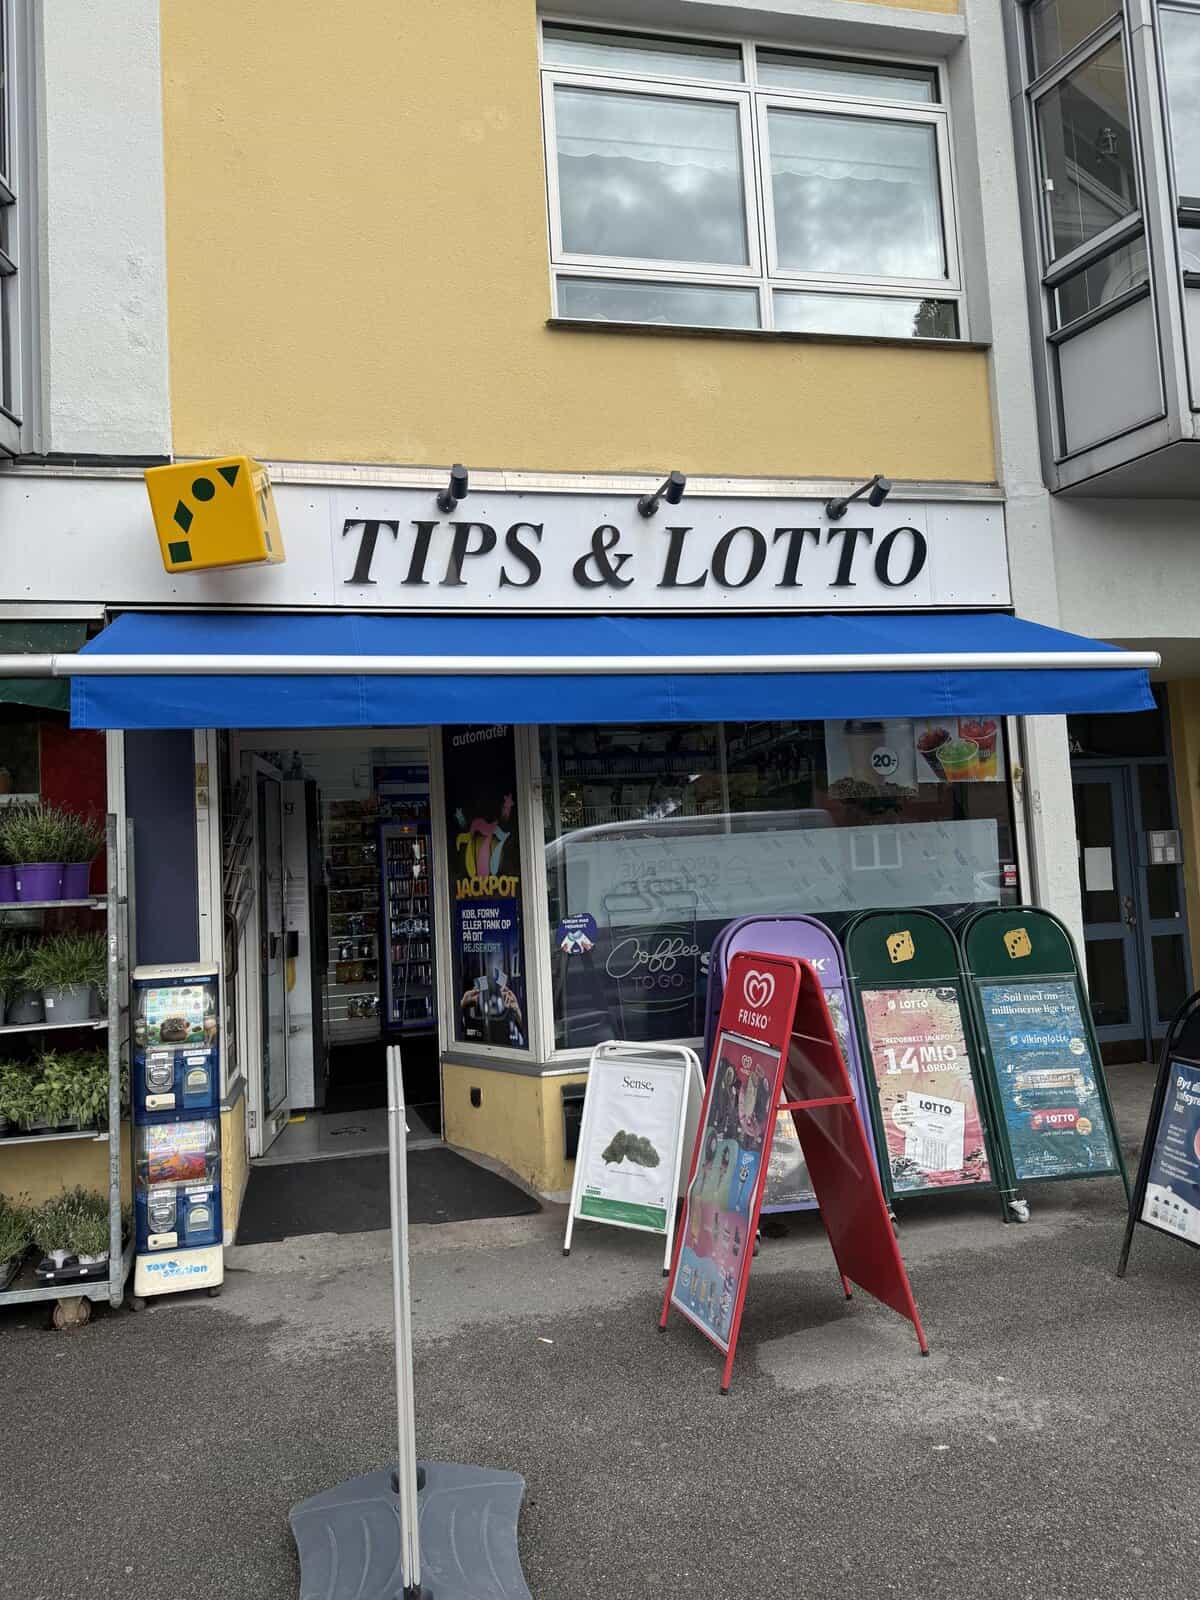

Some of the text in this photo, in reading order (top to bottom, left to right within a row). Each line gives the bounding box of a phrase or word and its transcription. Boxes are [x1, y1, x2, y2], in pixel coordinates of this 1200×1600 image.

[342, 518, 929, 589] TIPS & LOTTO
[456, 875, 519, 899] JACKPOT
[477, 908, 500, 919] FORNY
[462, 919, 512, 931] ELLER TANK OP
[462, 930, 483, 941] PÅ DIT
[463, 943, 501, 953] REJSEKORT
[605, 937, 702, 979] Coffee
[632, 973, 684, 992] TO GO
[1002, 992, 1021, 1003] Spil
[1023, 990, 1043, 1001] med
[899, 999, 928, 1009] LOTTO
[737, 1009, 768, 1030] FRISKO
[883, 1046, 920, 1075] 14
[919, 1044, 957, 1063] MIO
[921, 1062, 960, 1073] LØRDAG
[1176, 1076, 1192, 1090] Byt
[919, 1100, 952, 1115] LOTTO
[1046, 1113, 1075, 1124] LOTTO
